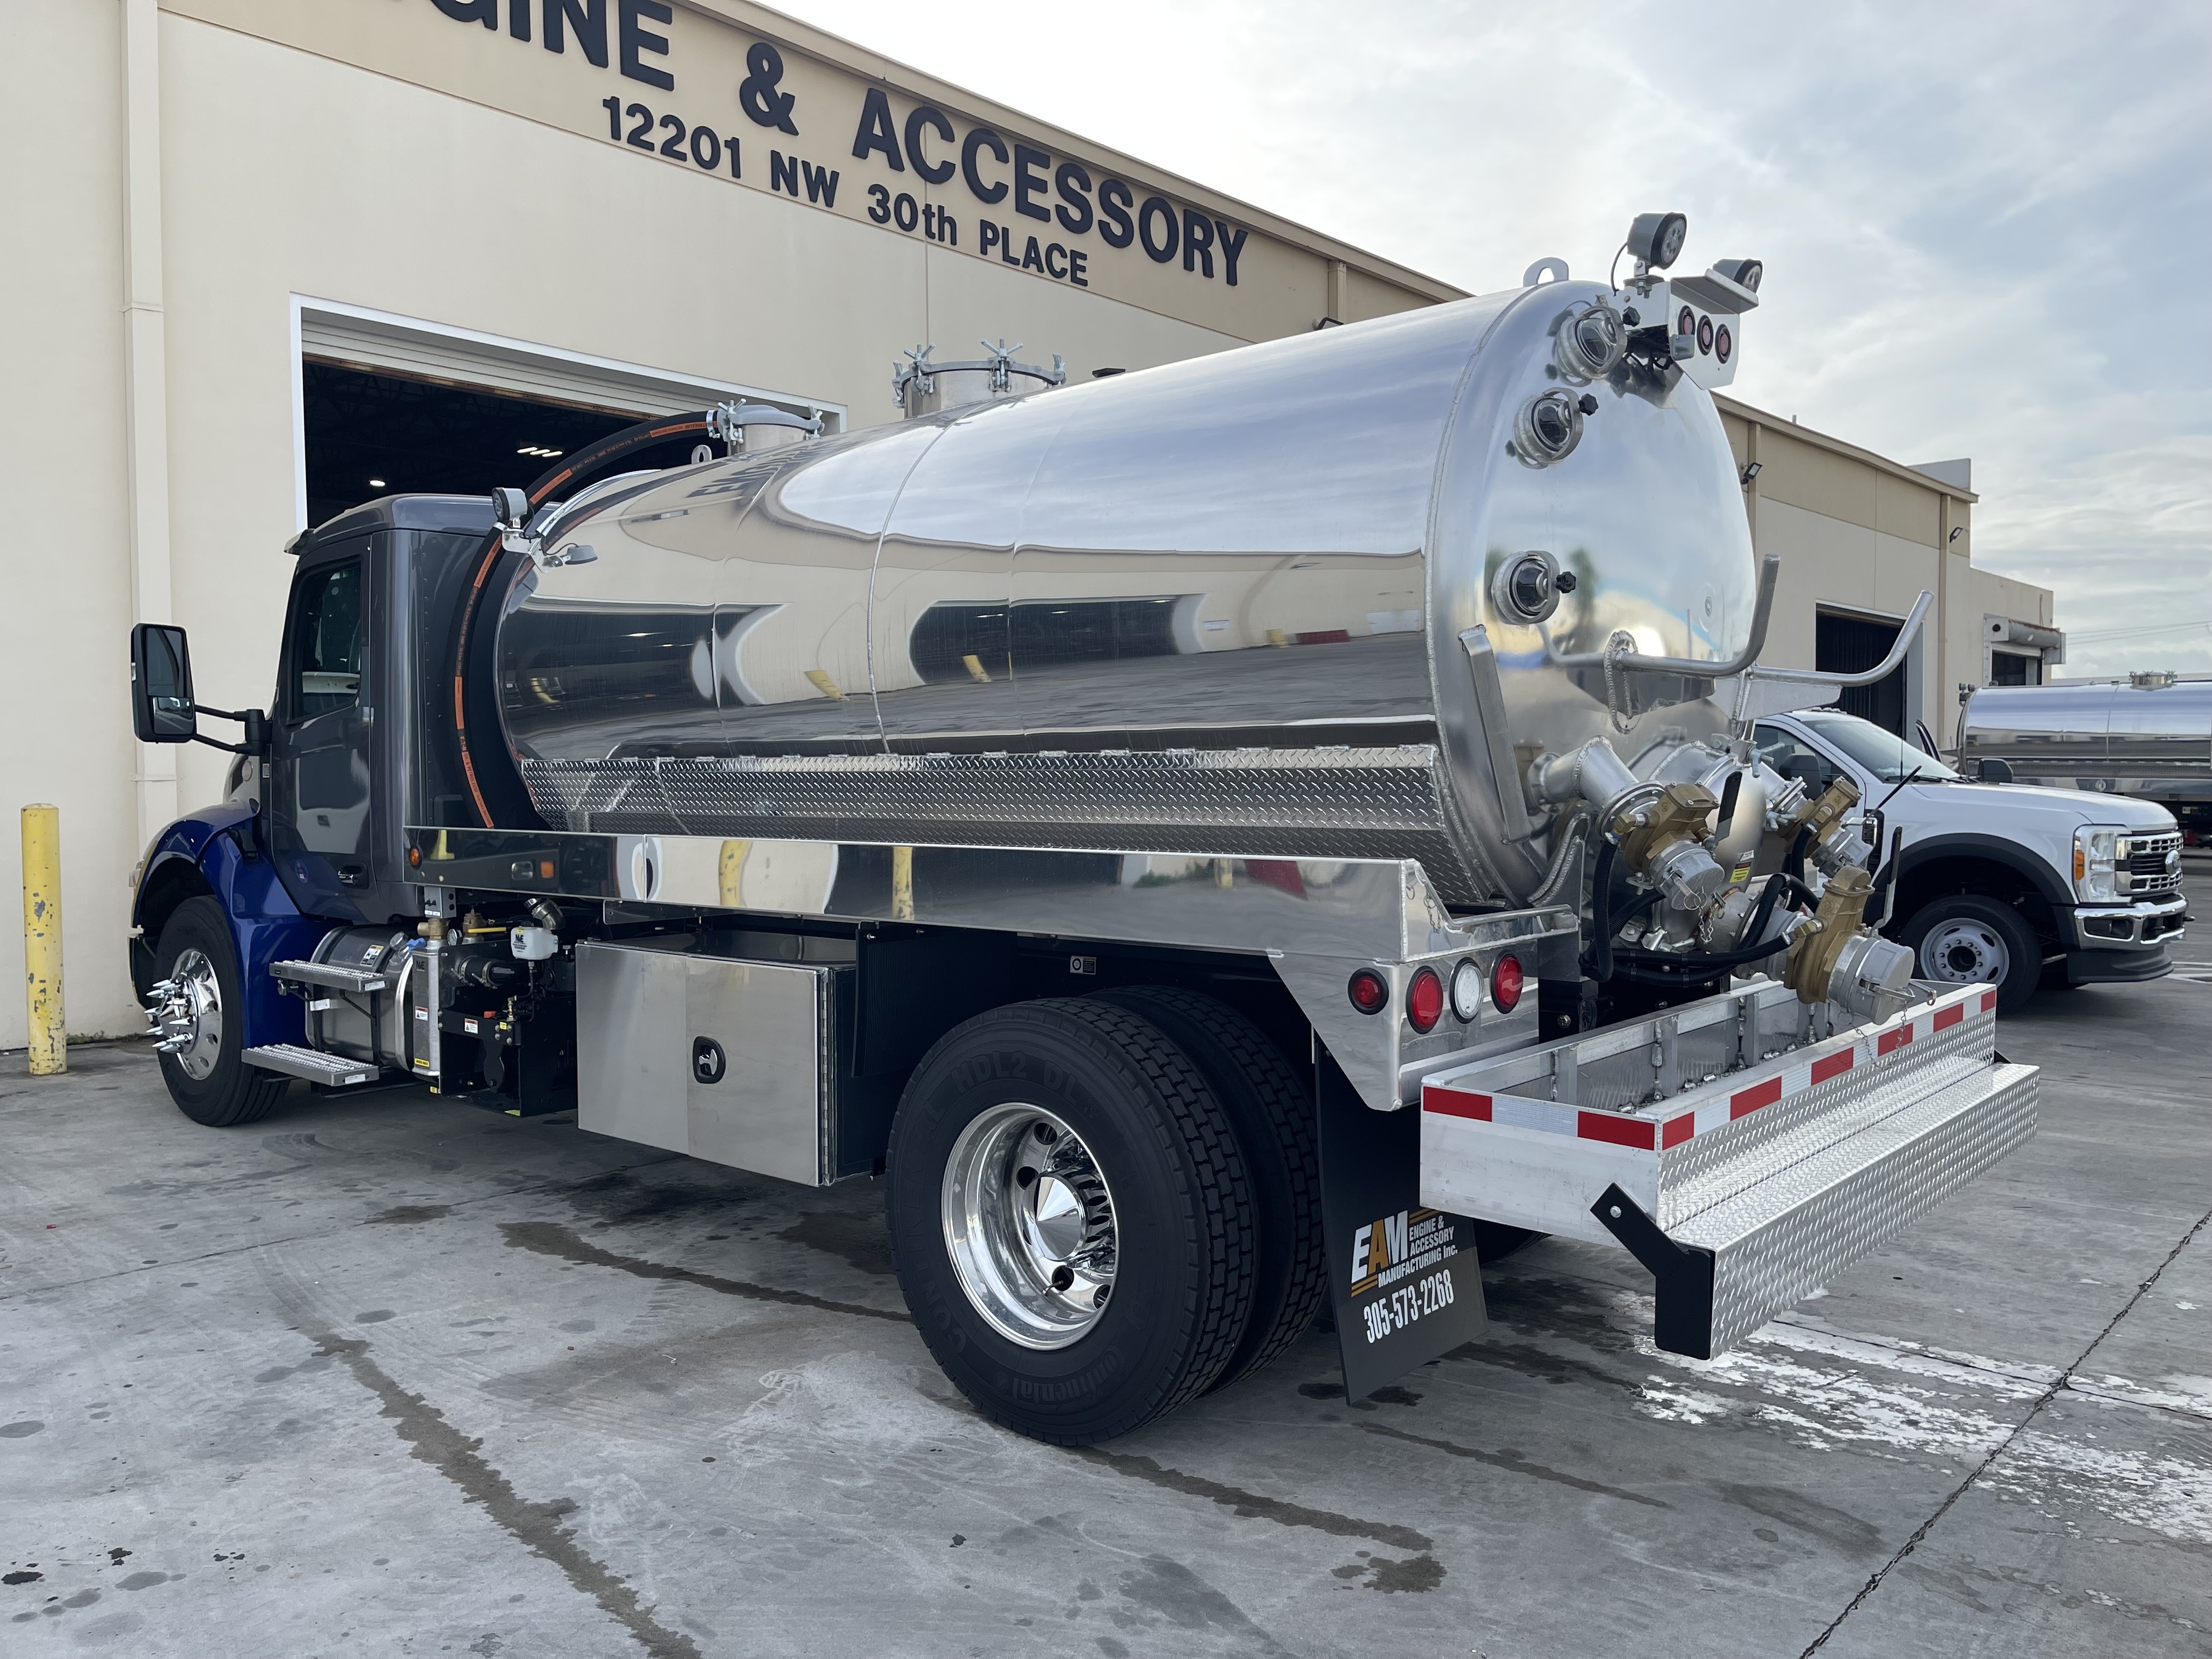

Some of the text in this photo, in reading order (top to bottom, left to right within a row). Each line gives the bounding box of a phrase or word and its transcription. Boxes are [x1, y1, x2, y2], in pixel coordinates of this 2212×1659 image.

[602, 96, 1088, 286] 12201 NW 30th PLACE
[739, 42, 799, 136] &
[852, 88, 1248, 286] ACCESSORY
[950, 1050, 1078, 1105] HDL2 DL
[1351, 1210, 1408, 1284] EAM
[1409, 1215, 1444, 1241] ENGINE &
[1410, 1226, 1454, 1256] ACCESSORY
[1378, 1244, 1458, 1288] MANUFACTURING Inc.
[1363, 1269, 1454, 1343] 305-573-2268
